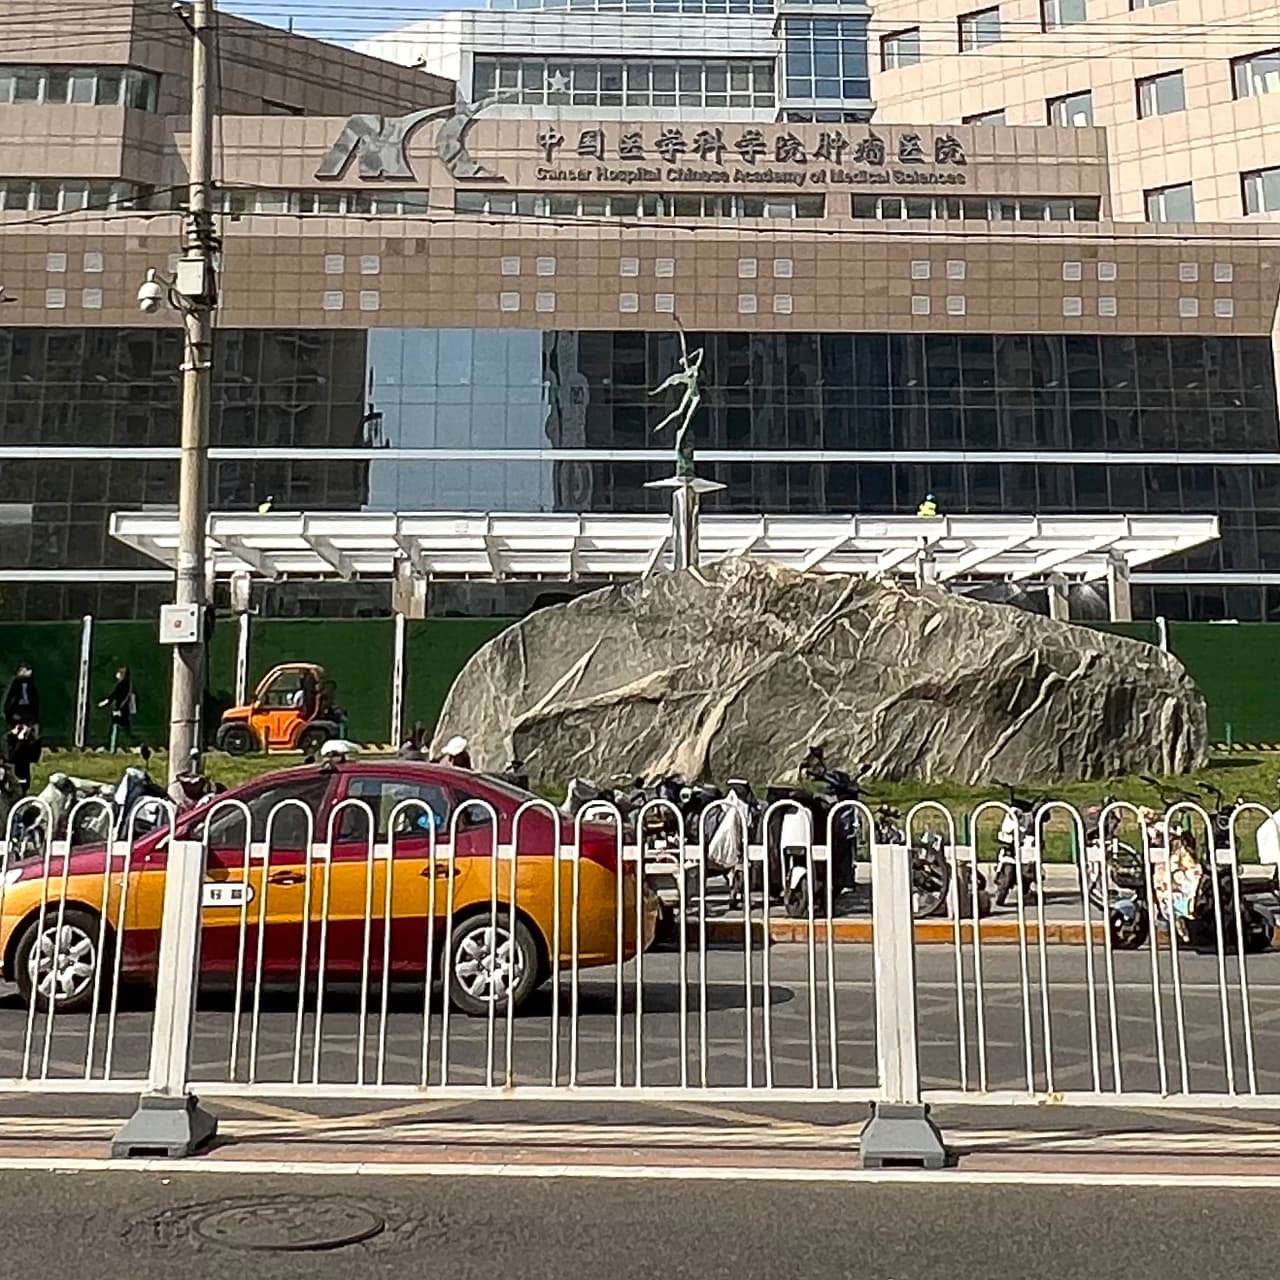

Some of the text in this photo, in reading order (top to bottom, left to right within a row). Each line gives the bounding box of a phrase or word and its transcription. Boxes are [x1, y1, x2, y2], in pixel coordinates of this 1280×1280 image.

[539, 126, 967, 166] 中国医学科学院肿瘤医院
[536, 167, 966, 187] Cancer Hospital Chinese Academy of Medical Sciences
